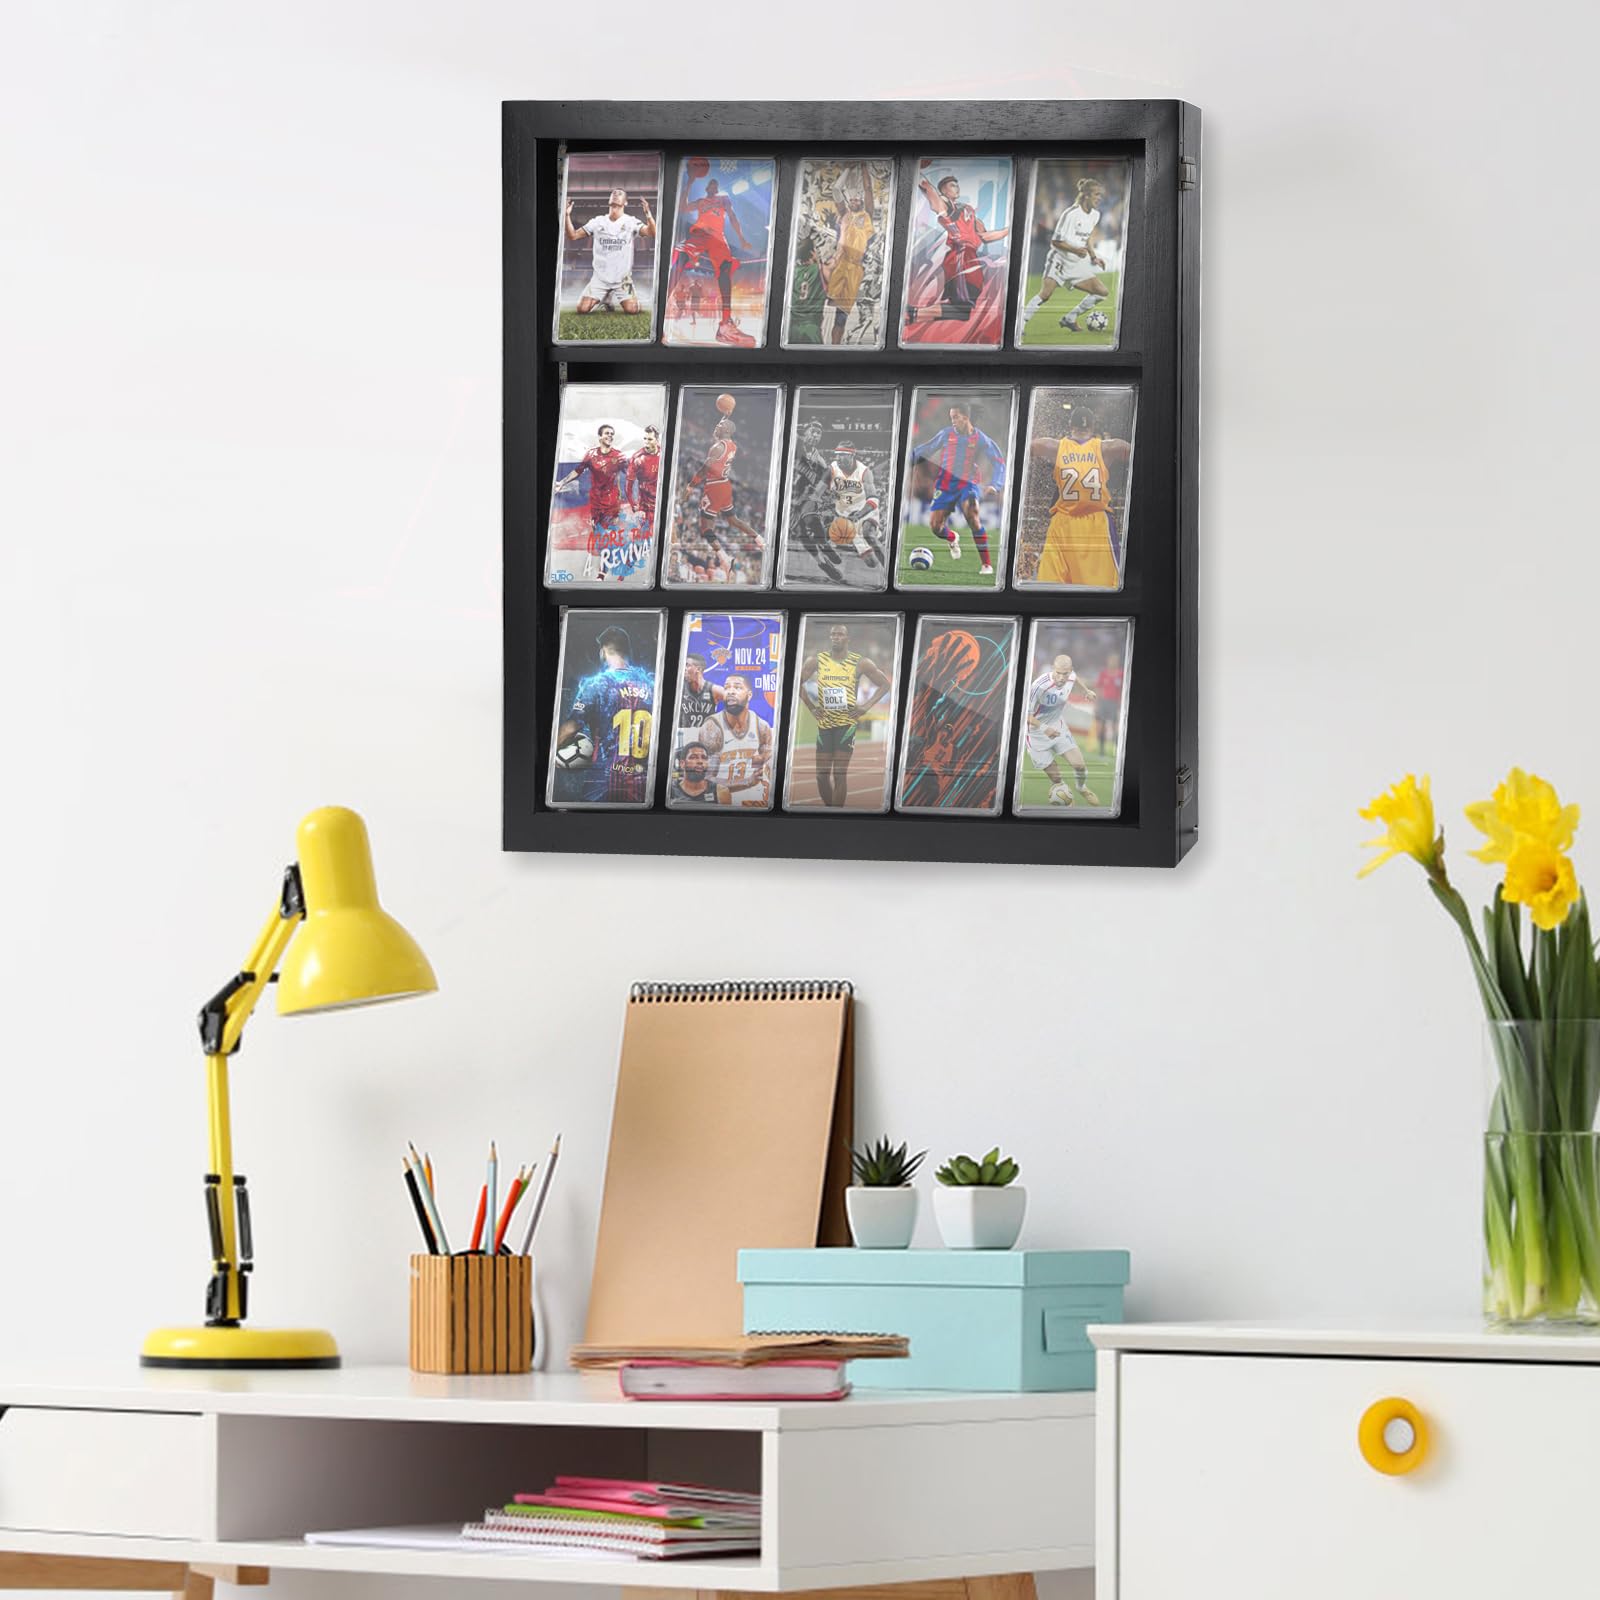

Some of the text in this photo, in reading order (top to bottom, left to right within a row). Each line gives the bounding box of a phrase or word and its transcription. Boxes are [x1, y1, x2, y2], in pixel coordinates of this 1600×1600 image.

[599, 237, 627, 245] Emirates
[1060, 467, 1102, 502] 24
[846, 495, 853, 504] 3
[587, 529, 625, 554] MORE
[582, 553, 593, 577] A
[551, 573, 575, 581] EURO
[734, 647, 755, 665] NOV.
[755, 647, 767, 665] 24
[619, 686, 649, 700] MESSI
[1046, 694, 1057, 705] 10
[681, 700, 713, 714] BKLYN
[824, 696, 844, 705] BOLT
[690, 714, 704, 728] 22
[612, 708, 653, 759] 10
[727, 761, 747, 784] 13
